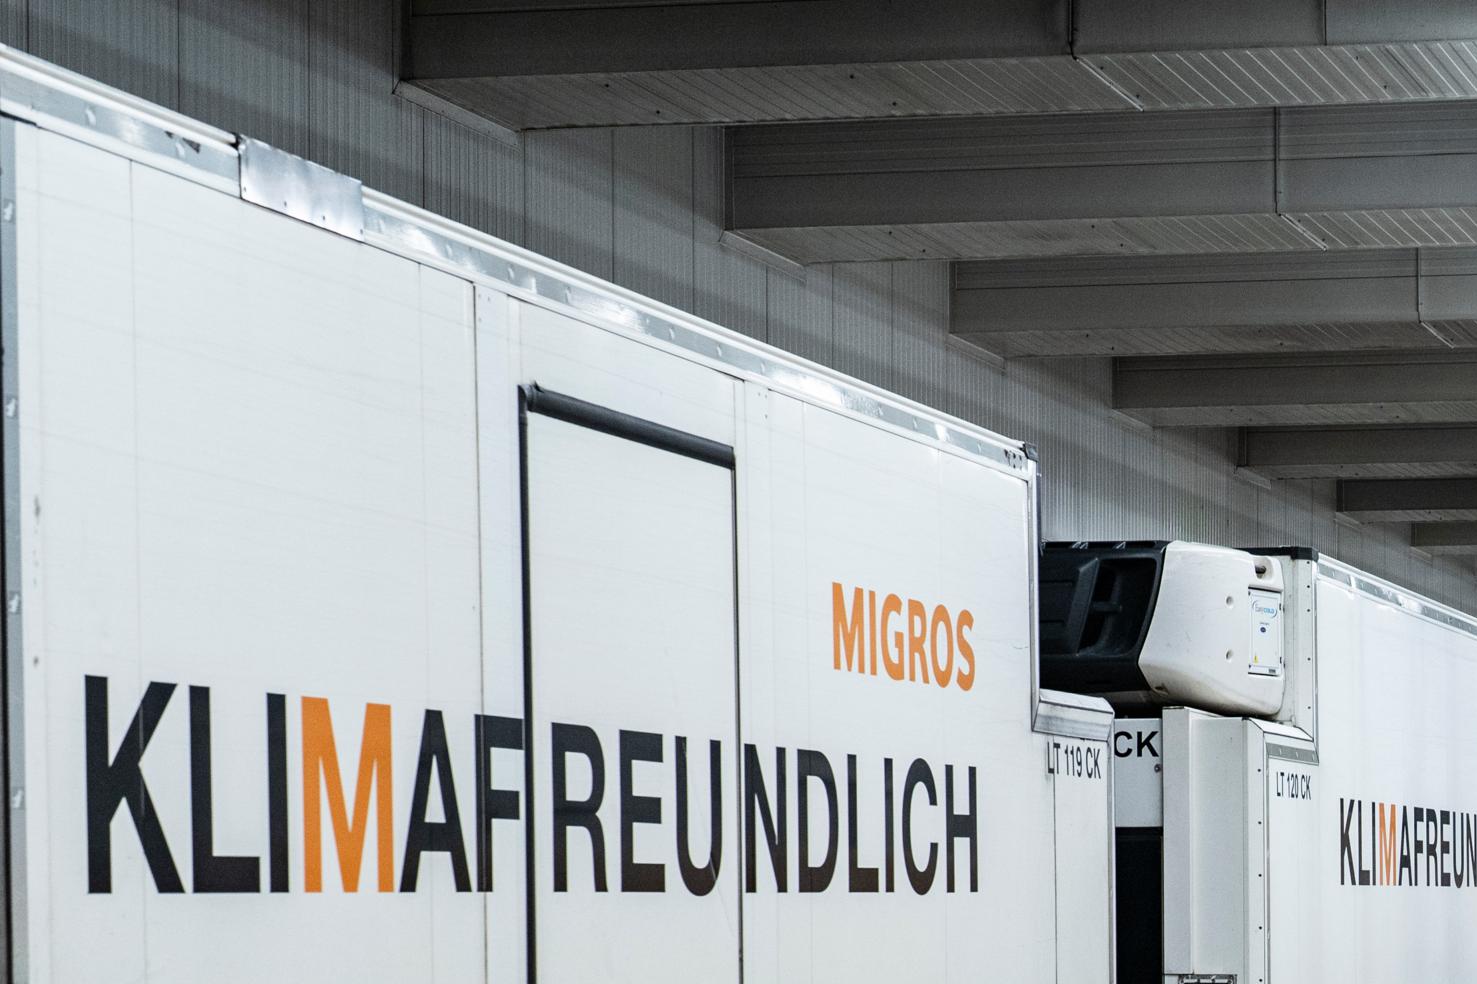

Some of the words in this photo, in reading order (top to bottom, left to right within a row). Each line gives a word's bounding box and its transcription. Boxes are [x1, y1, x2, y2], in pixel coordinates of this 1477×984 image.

[832, 582, 976, 691] MIGROS
[84, 674, 978, 896] KLIMAFREUNDLICH
[1047, 741, 1061, 775] LT
[1065, 744, 1083, 778] 119
[1085, 746, 1102, 780] CK
[1276, 771, 1285, 797] LT
[1287, 773, 1299, 799] 120
[1300, 774, 1312, 801] CK
